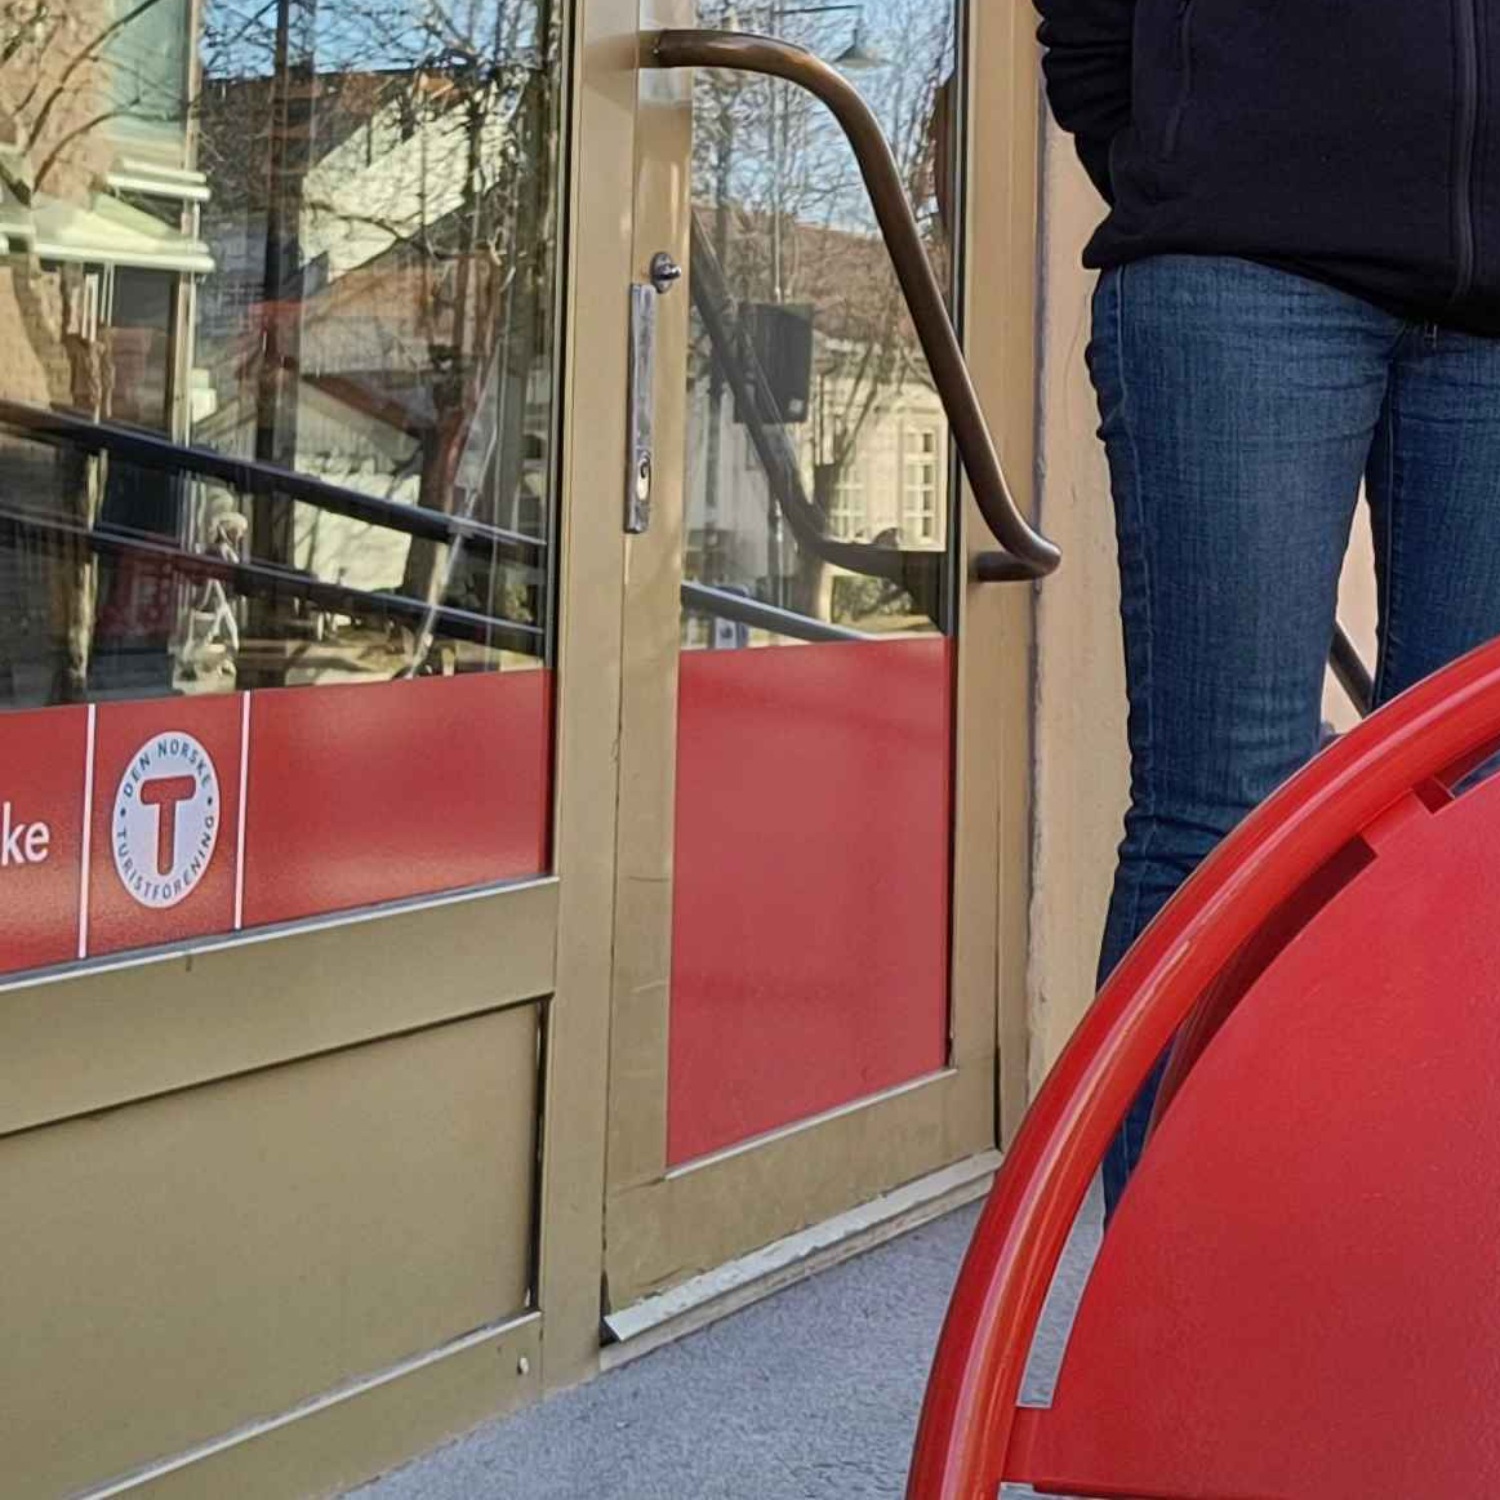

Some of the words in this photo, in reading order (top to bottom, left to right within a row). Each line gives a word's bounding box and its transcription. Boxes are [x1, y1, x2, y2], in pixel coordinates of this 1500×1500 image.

[123, 756, 151, 799] DEN
[157, 738, 213, 788] NORSKE
[2, 800, 50, 867] ke
